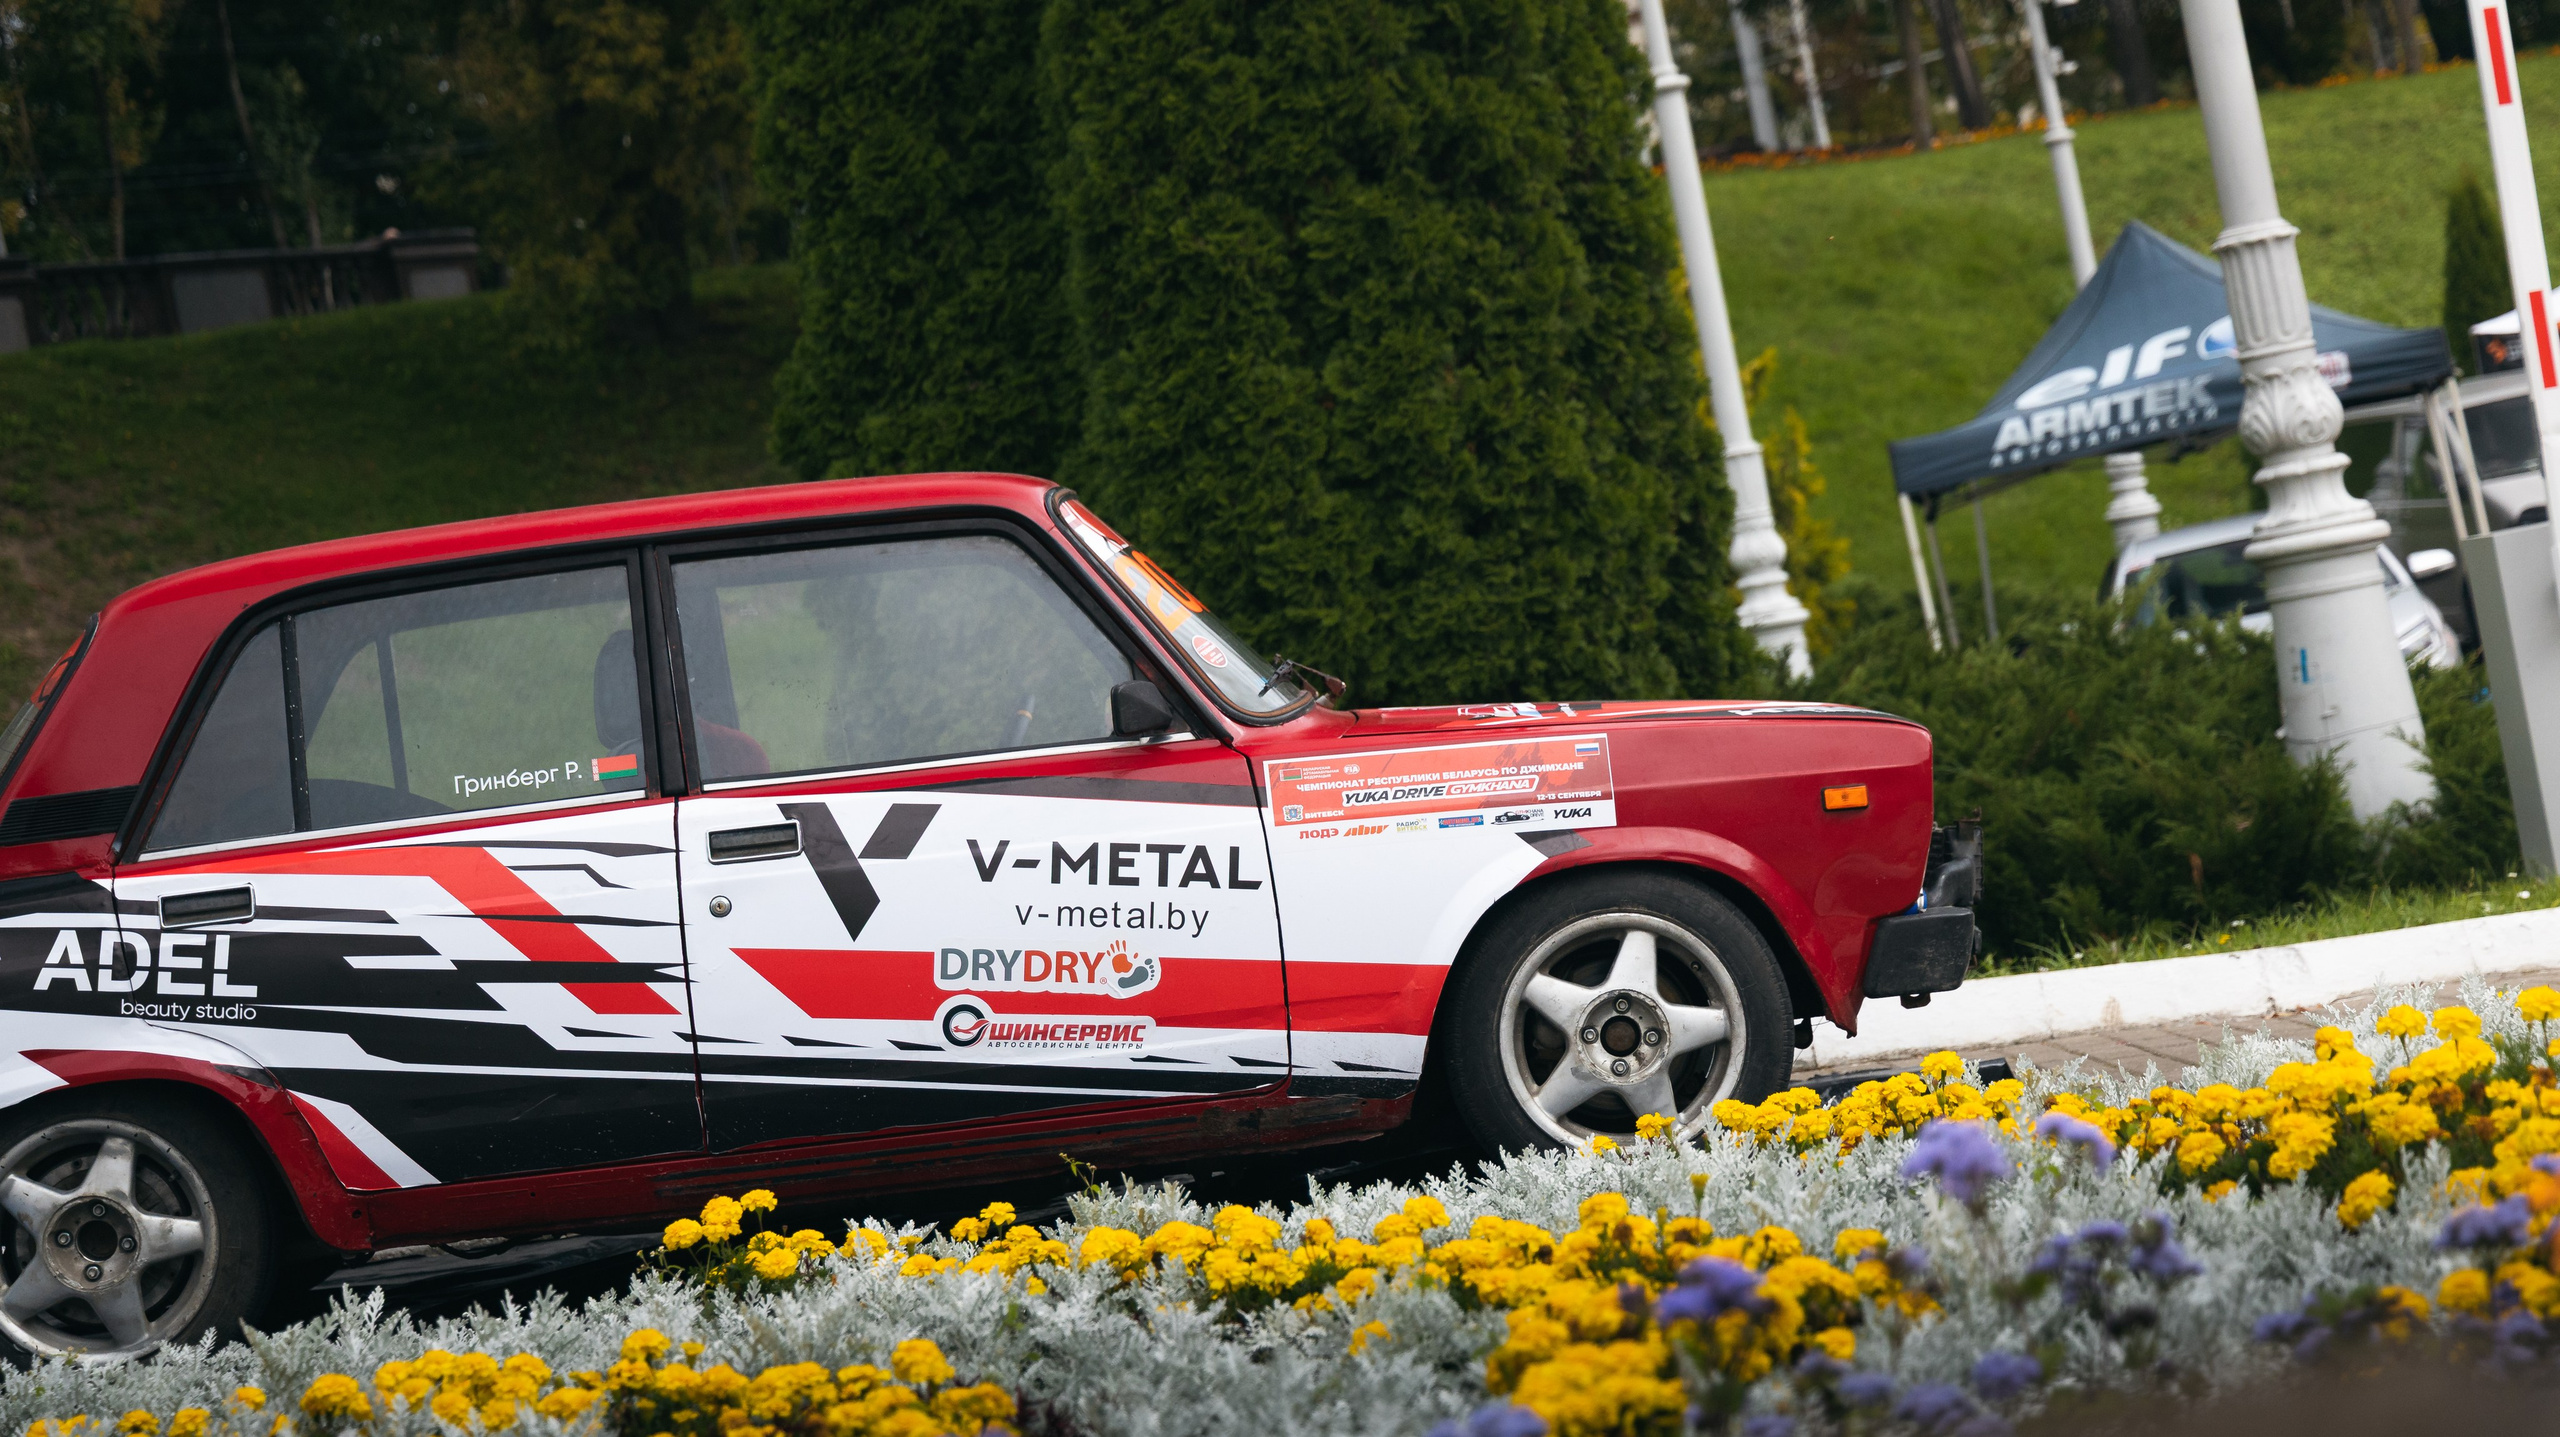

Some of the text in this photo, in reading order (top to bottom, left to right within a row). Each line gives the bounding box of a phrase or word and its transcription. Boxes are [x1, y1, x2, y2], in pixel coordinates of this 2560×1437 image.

[1992, 372, 2215, 453] ARMTEK
[454, 761, 584, 796] Гринберг Р.
[1296, 761, 1585, 792] ЧЕМПИОНАТ РЕСПУБЛИКИ БЕЛАРУСЬ ПО ДЖИМХАНЕ
[1344, 765, 1359, 774] FIA
[1344, 779, 1530, 804] YUKA DRIVE GYMKHANA
[1557, 790, 1602, 799] СЕНТЯБРЯ
[1304, 809, 1345, 819] ВИТЕБСК
[1396, 820, 1420, 828] РАДИО
[1553, 807, 1592, 819] YUKA
[1299, 828, 1340, 840] ЛОДЭ
[966, 838, 1263, 891] V-METAL
[1015, 901, 1210, 939] v-metal.by
[33, 928, 258, 998] ADEL
[120, 997, 257, 1021] beauty studio
[988, 1022, 1147, 1043] ШИНСЕРВИС
[987, 1041, 1144, 1050] АВТОСЕРВИСНЫЕ ЦЕНТРЫ
